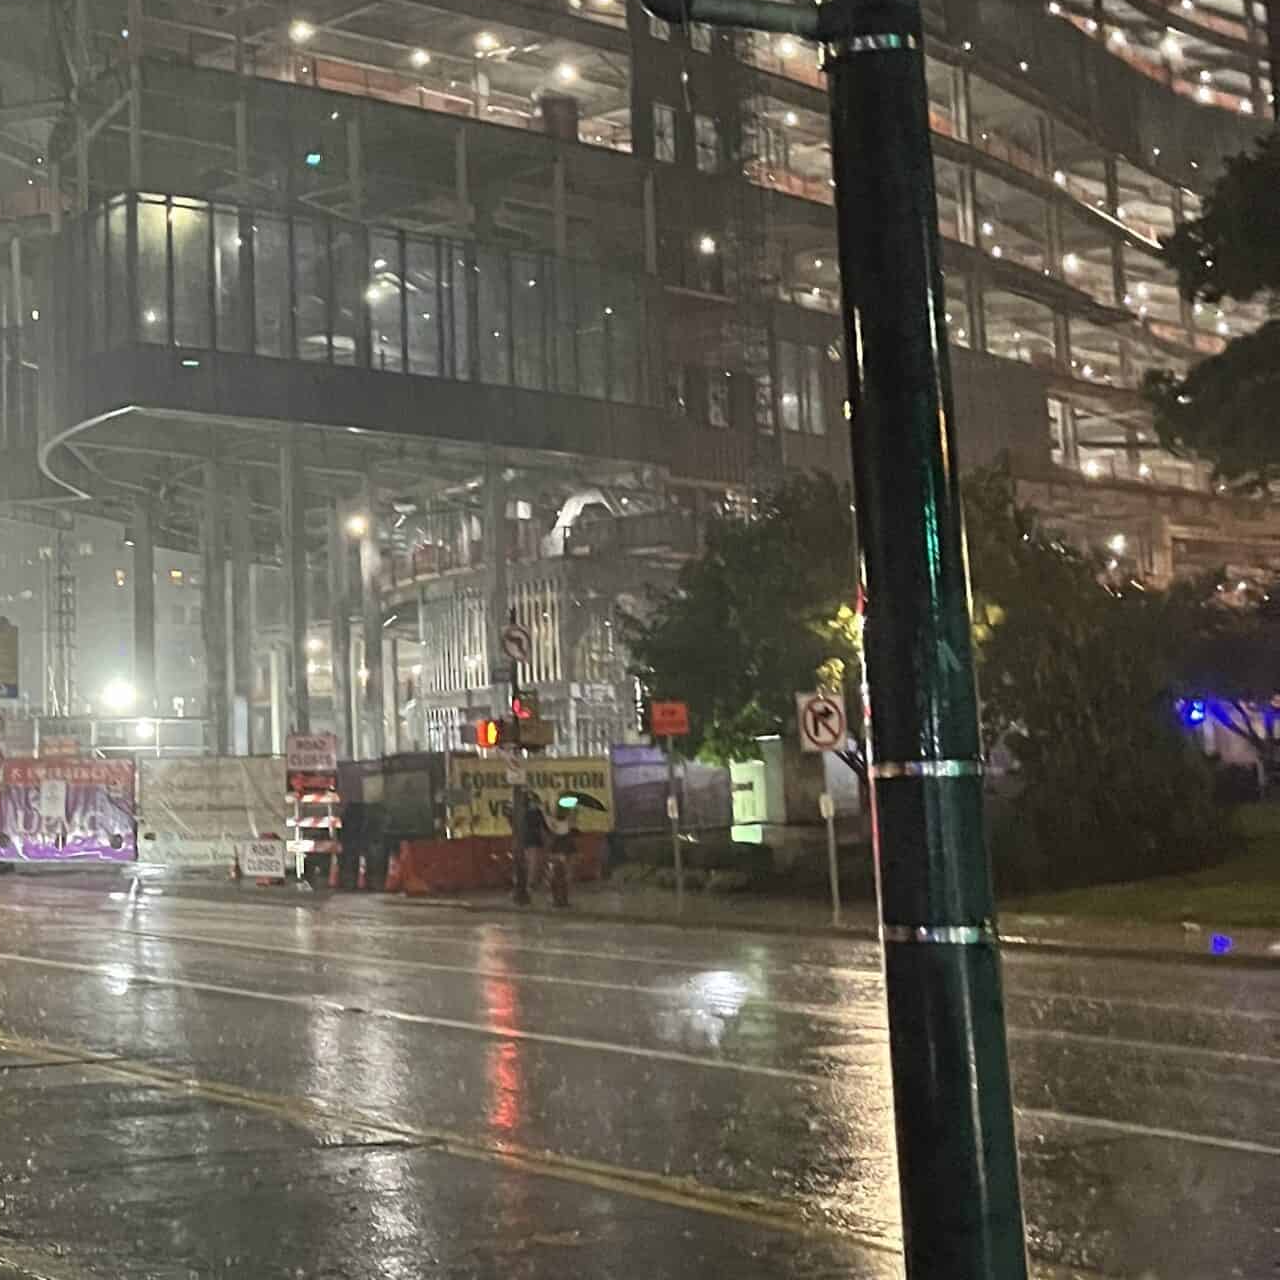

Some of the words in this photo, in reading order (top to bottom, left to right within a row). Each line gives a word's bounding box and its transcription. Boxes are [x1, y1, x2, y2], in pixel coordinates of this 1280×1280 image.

[296, 739, 327, 751] ROAD
[290, 753, 333, 767] CLOSED
[462, 771, 605, 789] CONSRUCTION
